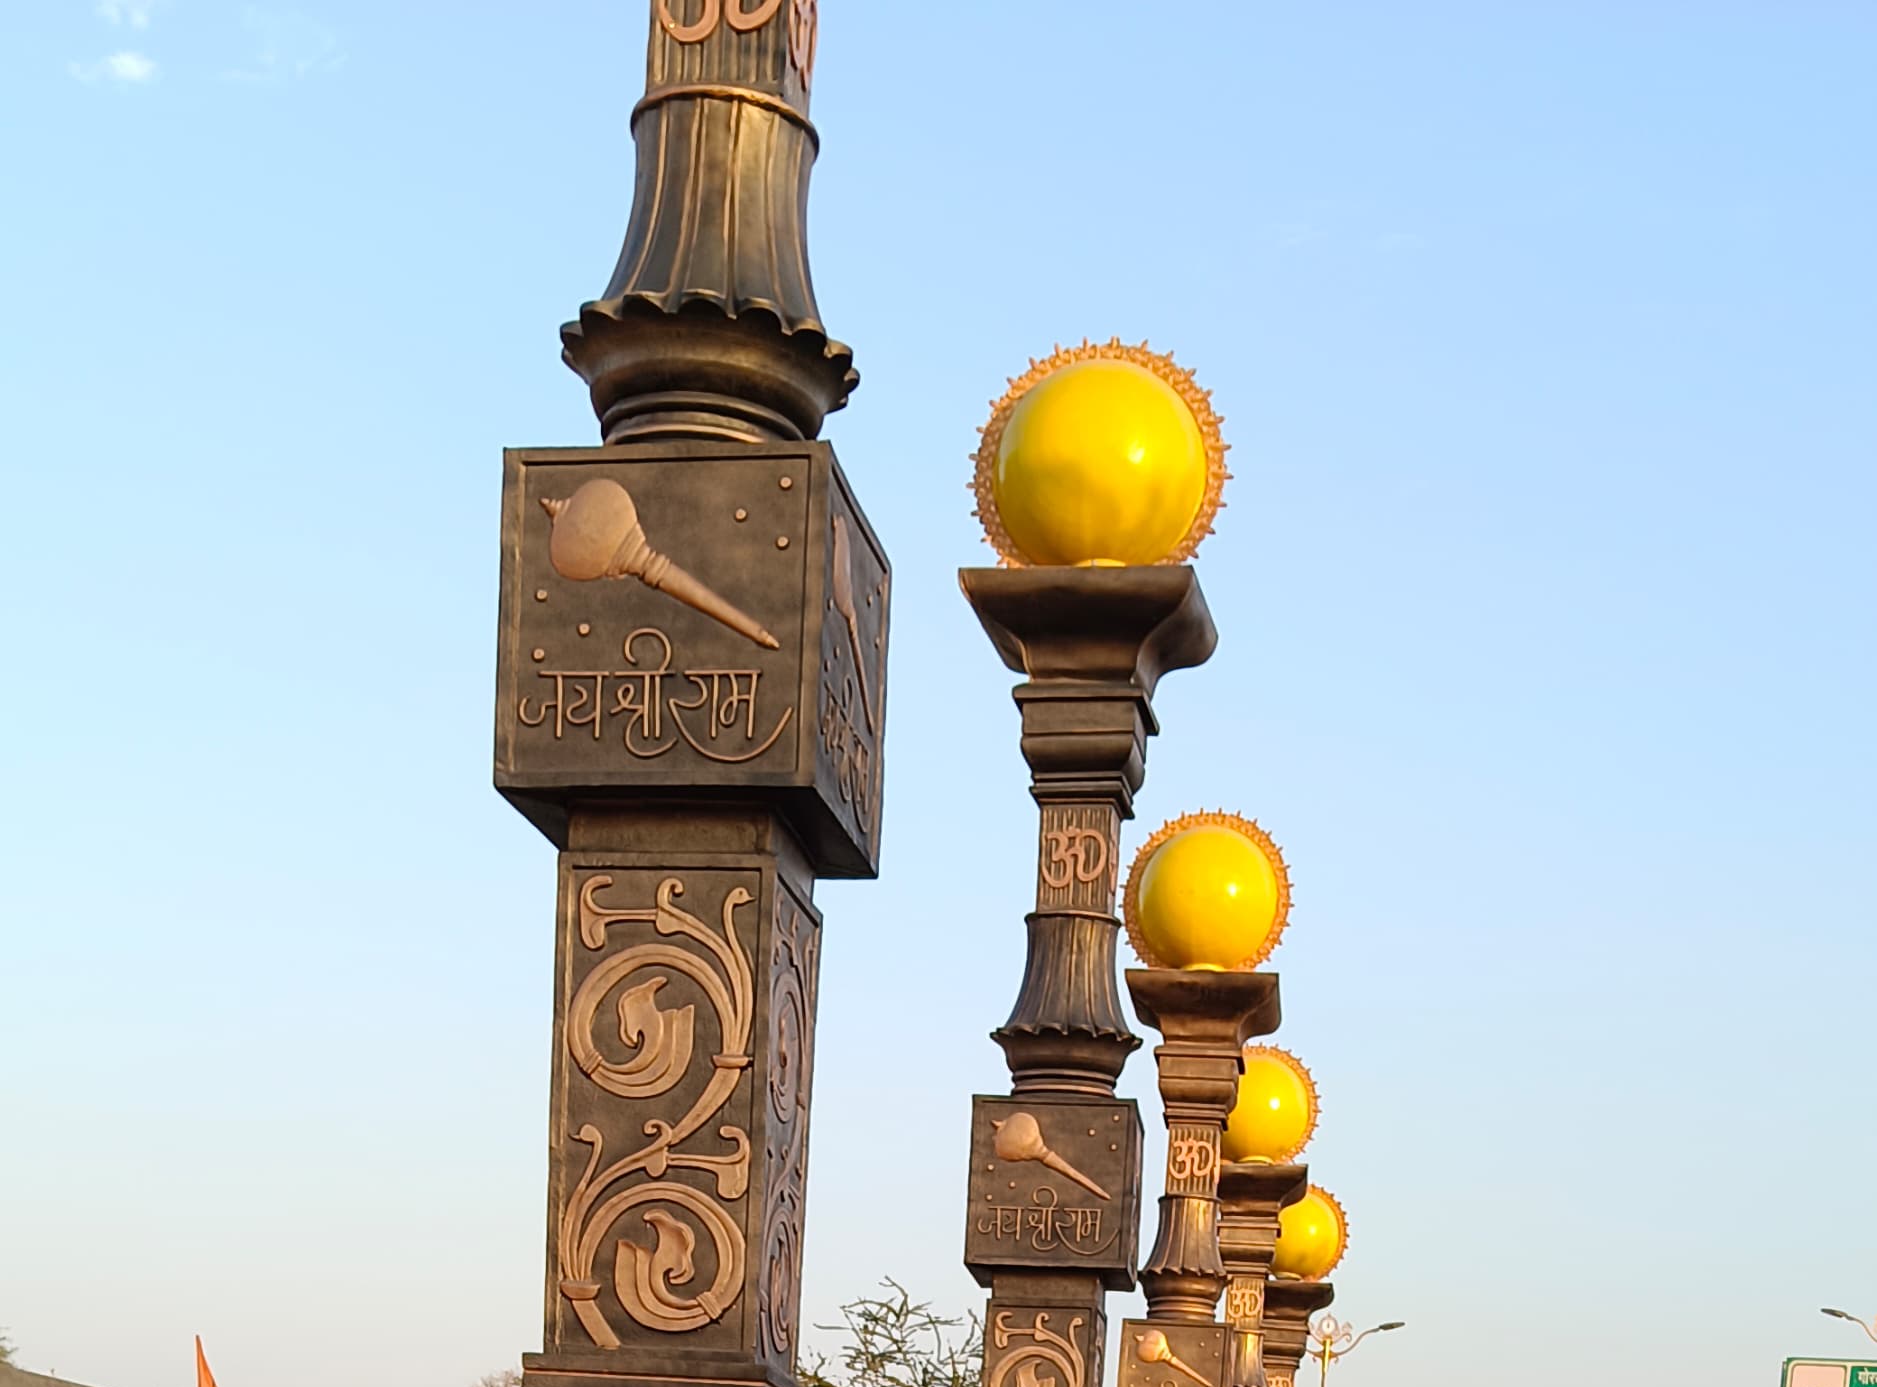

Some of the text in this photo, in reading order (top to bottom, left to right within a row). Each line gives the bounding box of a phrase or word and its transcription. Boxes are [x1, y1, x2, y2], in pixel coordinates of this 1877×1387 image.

[518, 627, 794, 763] जय श्री राम
[977, 1185, 1120, 1256] जय श्री राम
